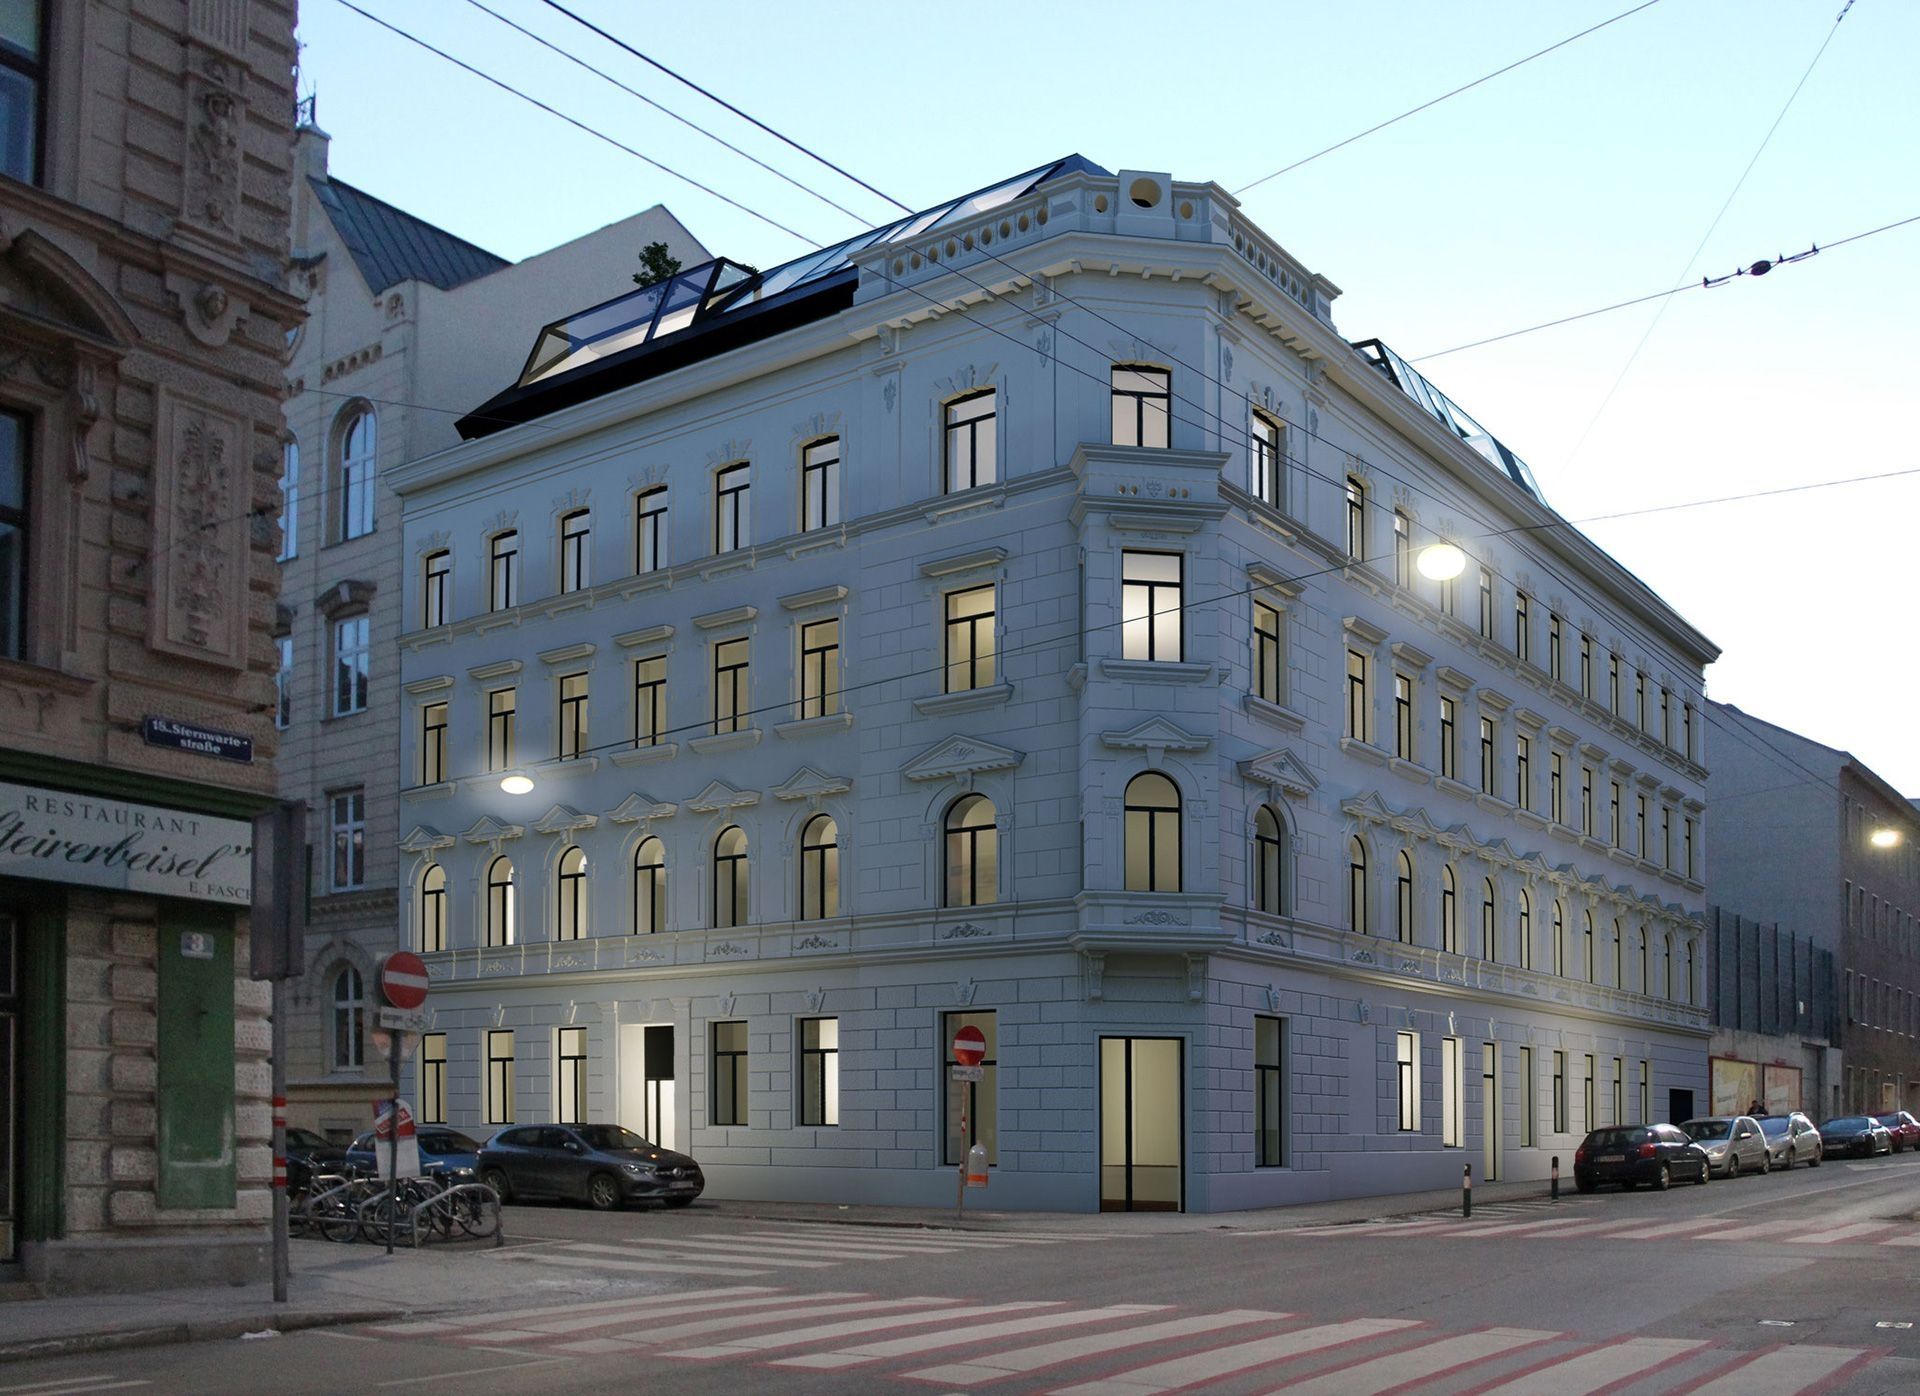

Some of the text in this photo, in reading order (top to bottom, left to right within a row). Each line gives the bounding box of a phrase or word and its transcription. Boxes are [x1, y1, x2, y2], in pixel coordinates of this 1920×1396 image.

[180, 738, 221, 754] straße
[26, 795, 200, 836] RESTAURANT
[191, 933, 204, 951] 3
